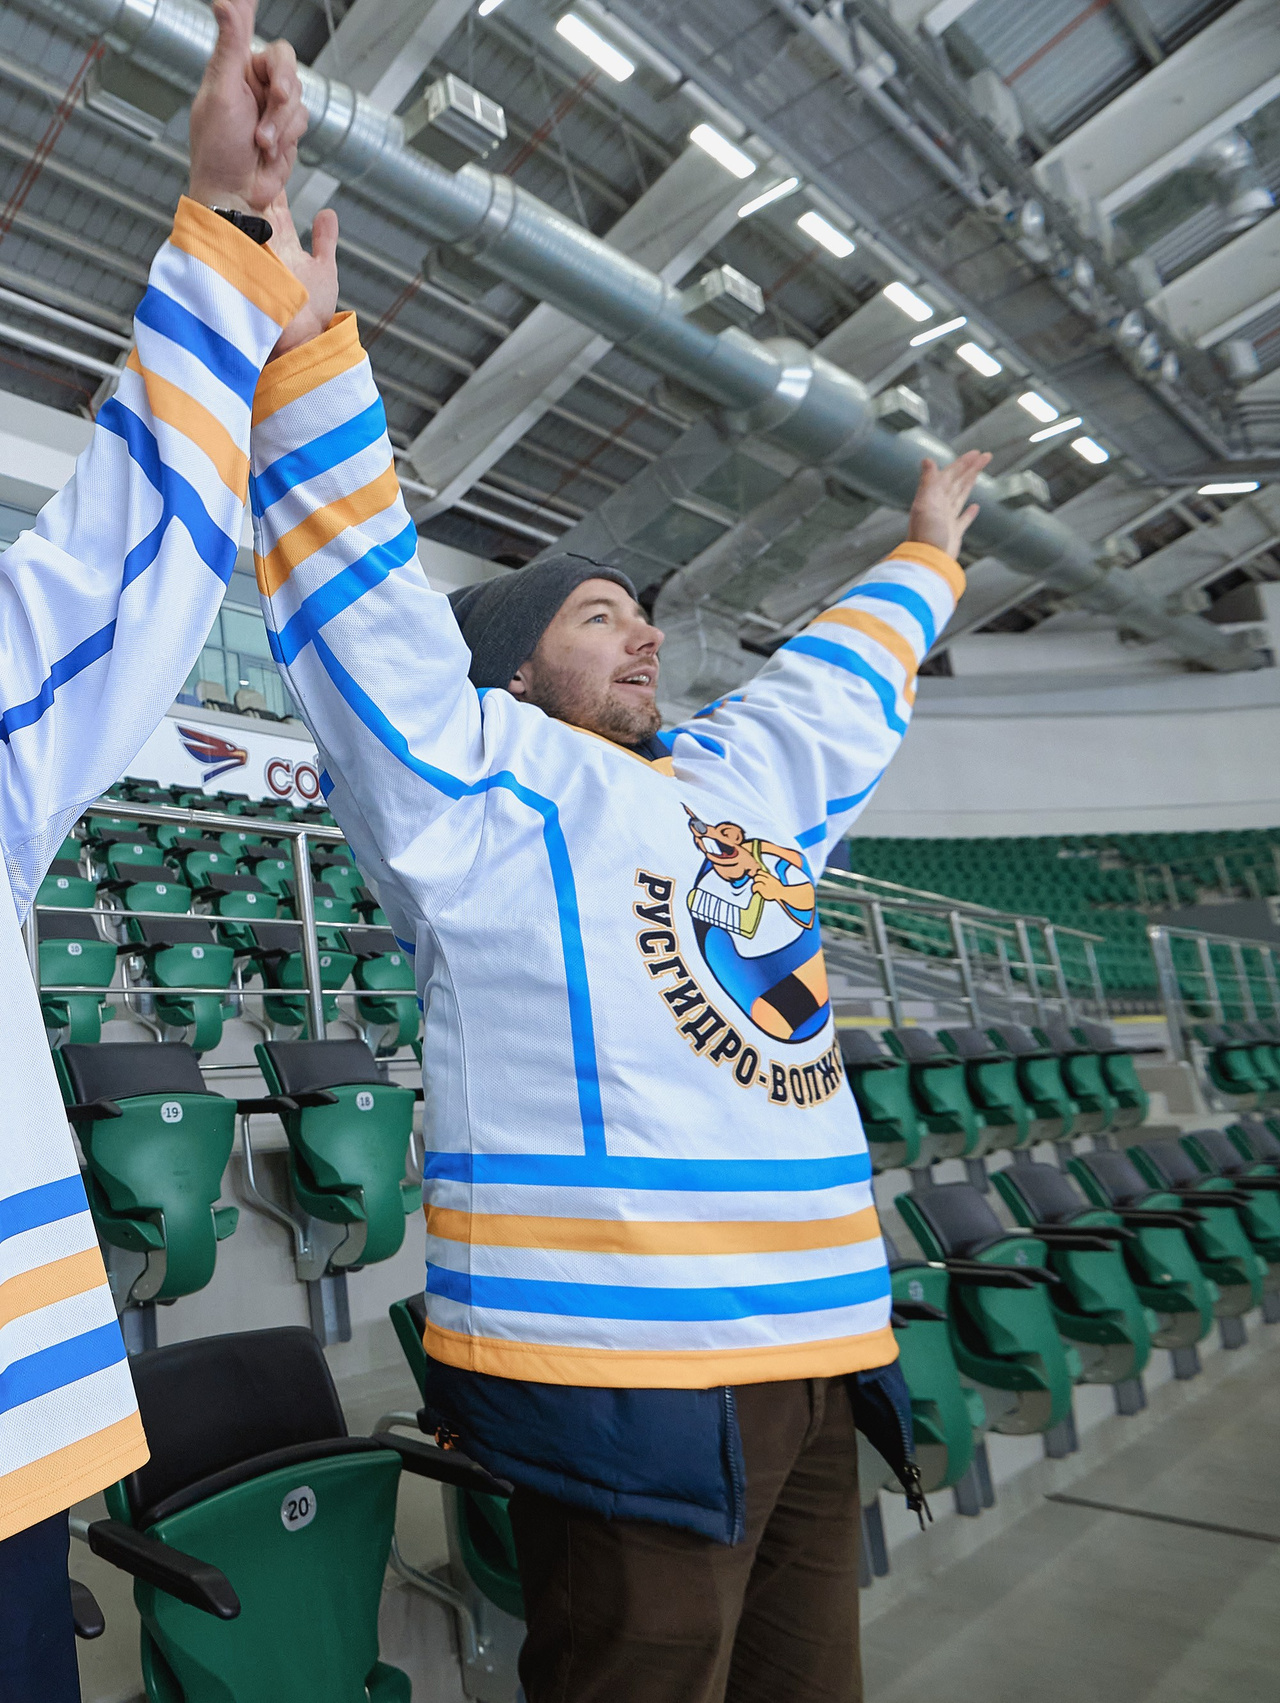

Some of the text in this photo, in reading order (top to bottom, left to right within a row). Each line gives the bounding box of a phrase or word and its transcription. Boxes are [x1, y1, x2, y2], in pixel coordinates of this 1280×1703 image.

[265, 754, 321, 801] СО
[632, 868, 843, 1109] РУСГИДРО-ВОЛЖ
[287, 1496, 310, 1522] 20
